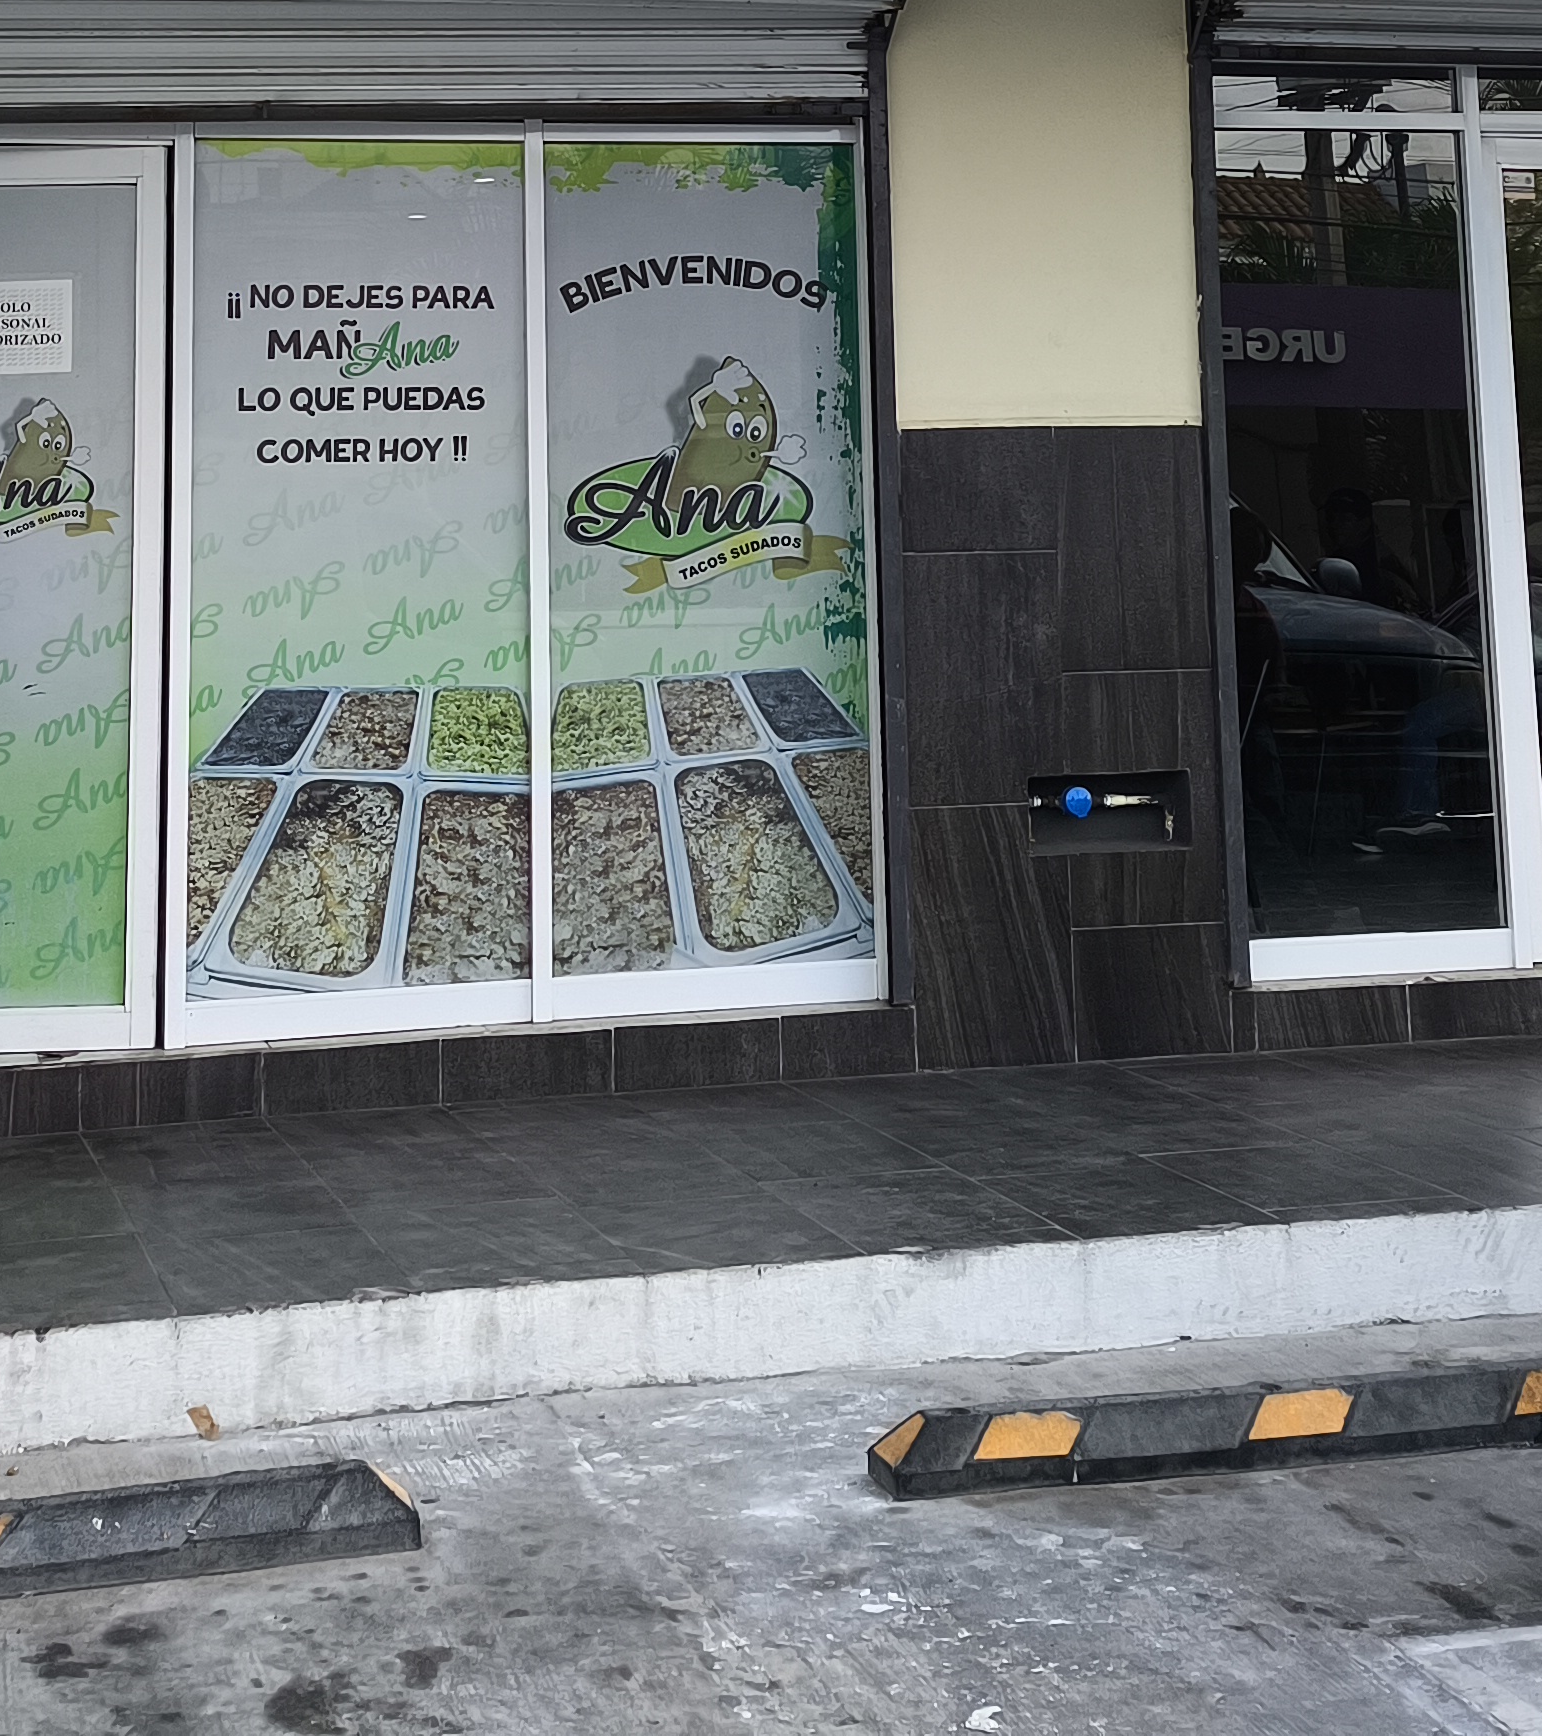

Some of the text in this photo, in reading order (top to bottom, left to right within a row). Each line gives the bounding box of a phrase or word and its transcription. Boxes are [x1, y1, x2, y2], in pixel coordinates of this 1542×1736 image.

[250, 284, 295, 308] NO
[303, 284, 404, 310] DEJES
[412, 284, 495, 310] PARA
[560, 255, 830, 315] BIENVENIDOS
[238, 386, 486, 416] LO QUE PUEDAS
[256, 438, 371, 464] COMER
[378, 437, 443, 463] HOY
[565, 448, 781, 546] Ana
[3, 508, 87, 538] TACOS SUDADOS
[678, 554, 728, 581] TACOS
[730, 535, 802, 564] SUDADOS
